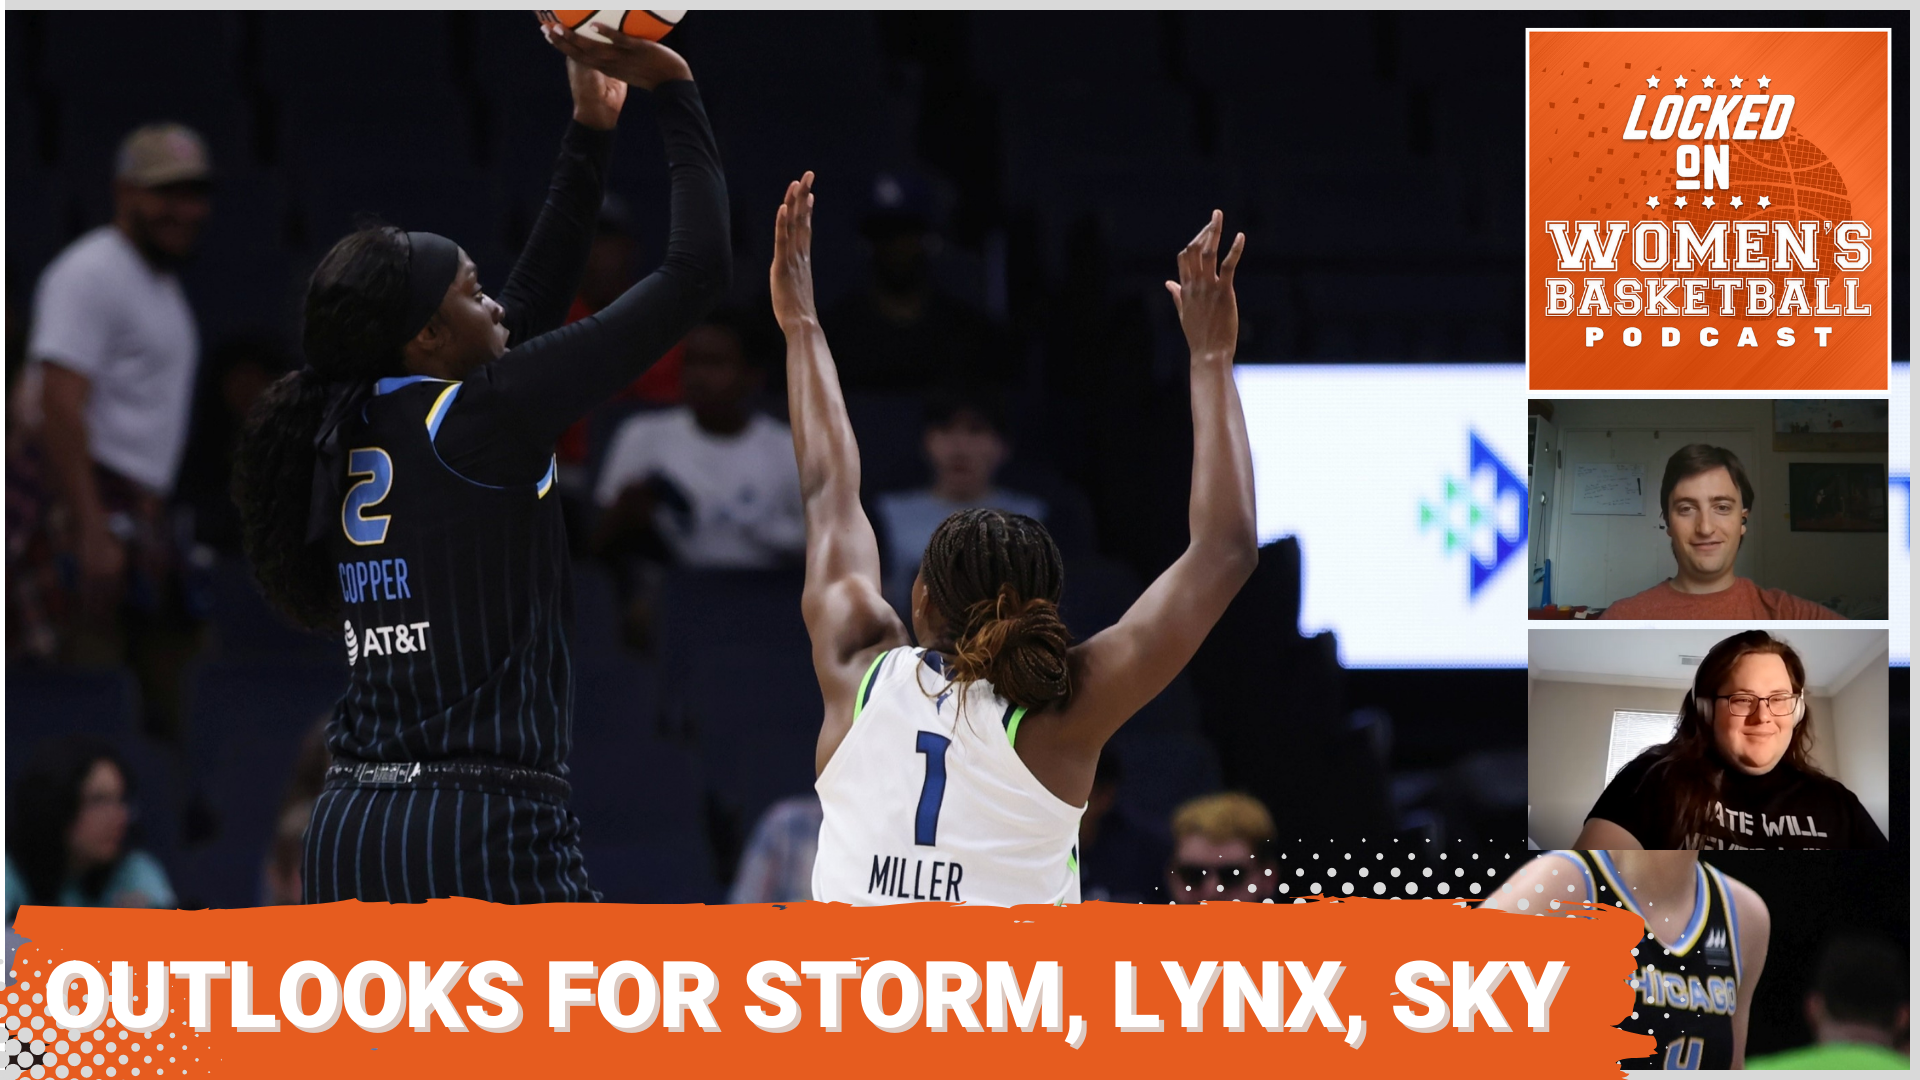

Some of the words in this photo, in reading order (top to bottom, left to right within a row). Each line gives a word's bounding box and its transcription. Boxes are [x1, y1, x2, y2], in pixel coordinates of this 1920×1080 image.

[342, 447, 393, 546] 2
[338, 558, 411, 604] COPPER
[363, 621, 430, 657] AT&T
[914, 730, 952, 847] 1
[1761, 813, 1828, 838] WILL
[867, 854, 963, 902] MILLER
[1627, 966, 1737, 1016] HICAGO
